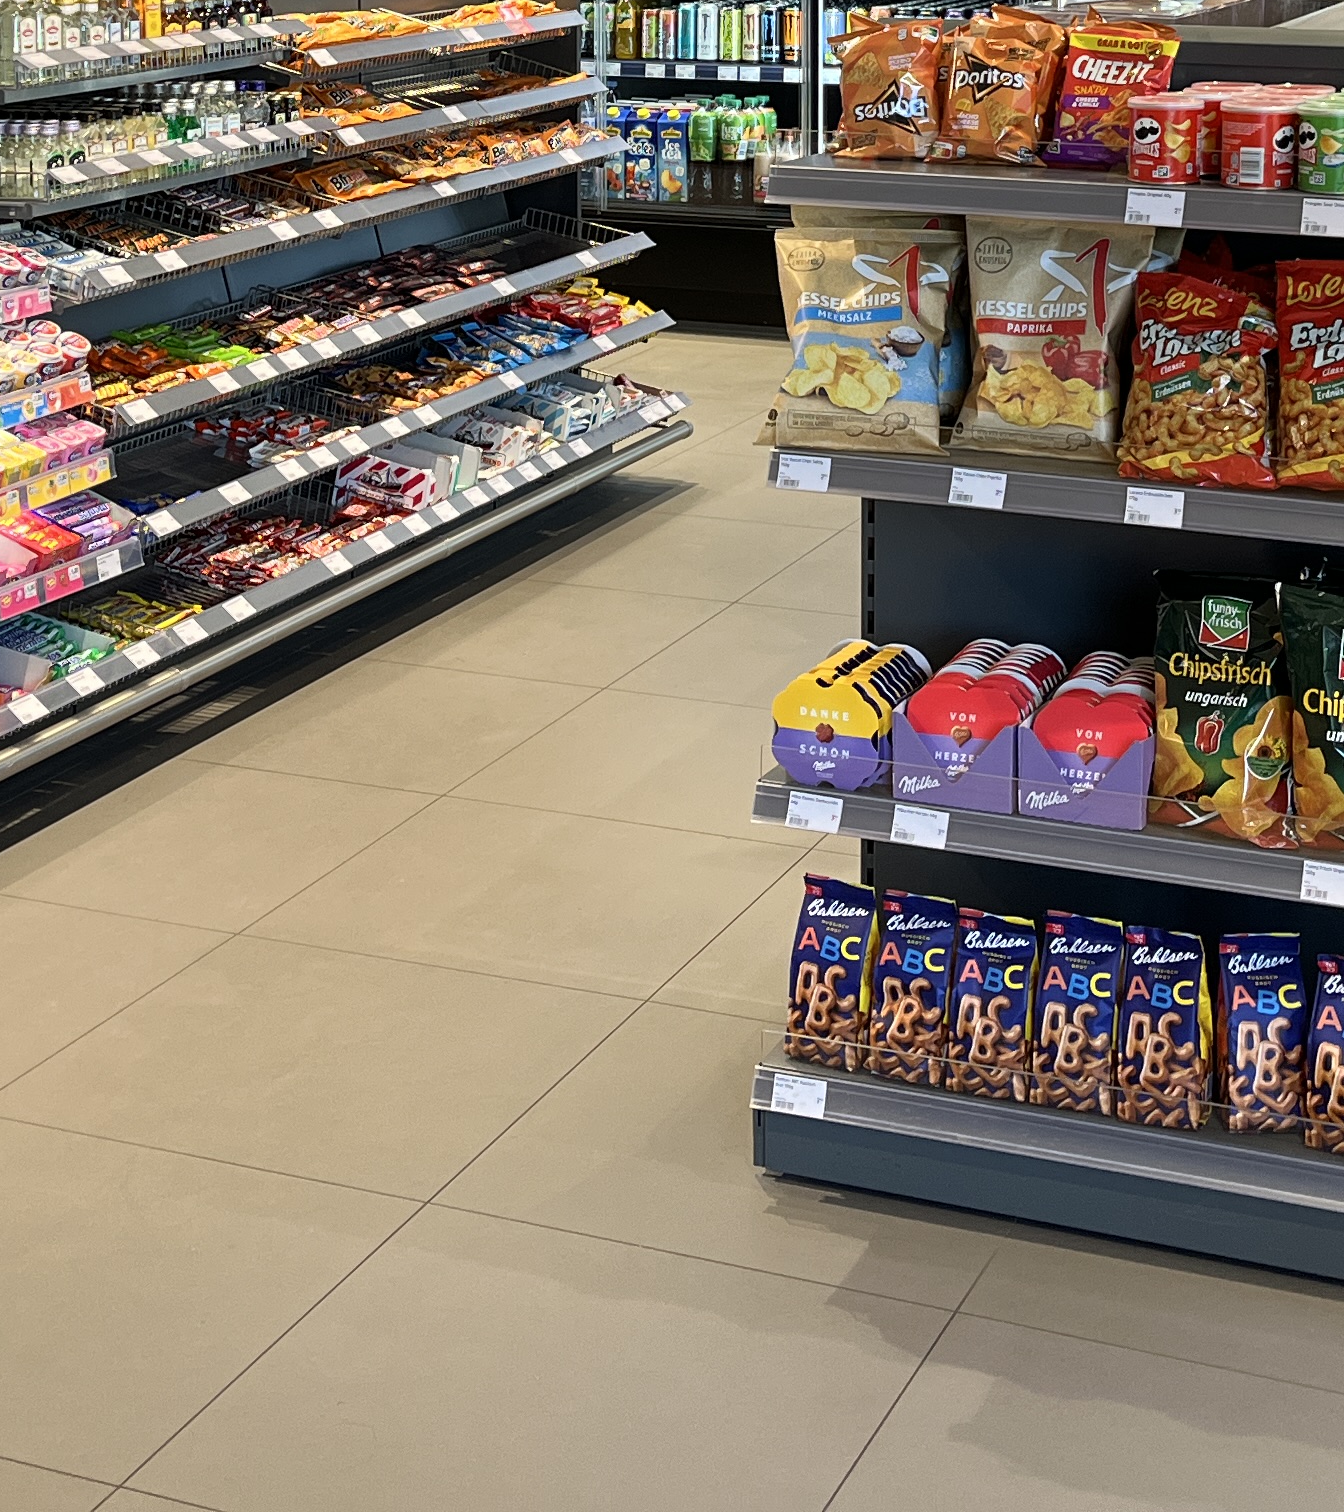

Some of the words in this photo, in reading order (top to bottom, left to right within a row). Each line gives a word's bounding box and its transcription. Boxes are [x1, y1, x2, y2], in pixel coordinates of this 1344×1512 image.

[1097, 39, 1118, 49] GRAB
[1128, 41, 1144, 50] GO!
[955, 68, 1025, 90] Doritos
[855, 97, 928, 122] Doritos
[851, 291, 902, 308] CHIPS
[975, 299, 1037, 319] KESSEL
[1039, 300, 1087, 319] CHIPS
[1138, 287, 1218, 319] Loenz
[817, 308, 872, 323] MEERSALZ
[1006, 322, 1053, 334] PAPRIKA
[1160, 360, 1186, 376] Classic
[1155, 380, 1192, 399] Erdnüssen
[1207, 613, 1244, 630] frisch
[1168, 651, 1272, 686] Chipsfrisch
[1184, 690, 1248, 708] ungarisch
[799, 706, 850, 722] DANKE
[949, 711, 977, 723] VON
[1074, 728, 1104, 741] VON
[898, 774, 941, 795] Milka
[1025, 790, 1070, 810] Milka
[807, 898, 869, 917] Bahlsen
[886, 913, 951, 931] Bahlsen
[798, 926, 862, 962] ABC
[964, 931, 1030, 949] Bahlsen
[1049, 937, 1117, 954] Bahlsen
[879, 941, 946, 975] ABC
[1131, 947, 1199, 966] Bahlsen
[1228, 954, 1294, 975] Bahlsen
[959, 958, 1025, 993] ABC
[1042, 966, 1112, 1001] ABC
[1126, 975, 1195, 1009] ABC
[1232, 983, 1302, 1015] ABC
